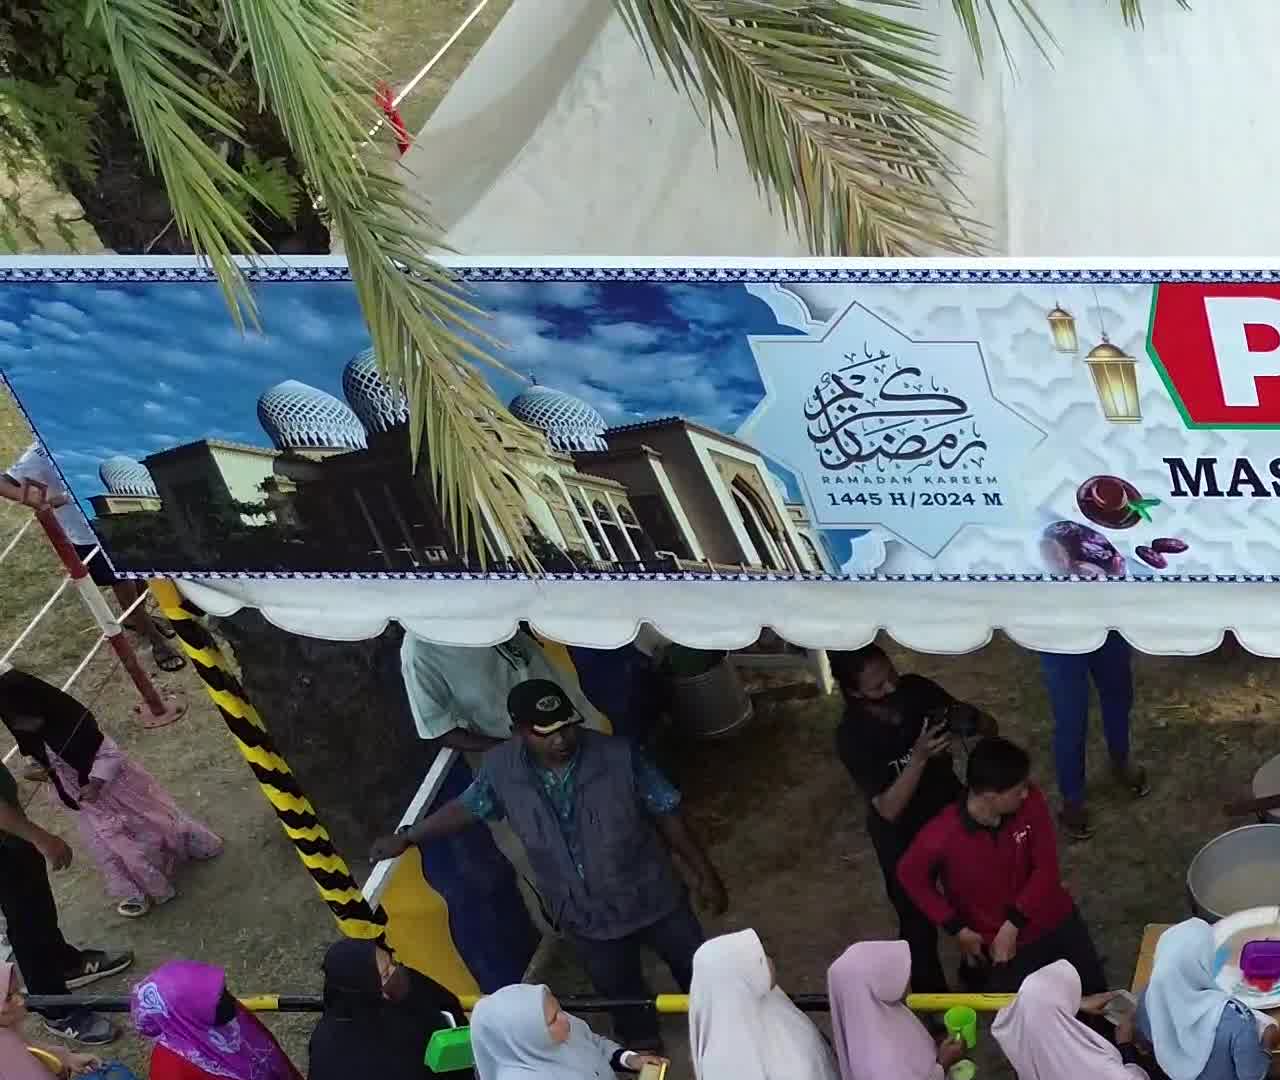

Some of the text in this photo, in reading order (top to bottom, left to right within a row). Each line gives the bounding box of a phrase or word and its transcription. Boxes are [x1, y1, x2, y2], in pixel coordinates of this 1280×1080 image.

[821, 475, 999, 485] RAMADAN KAREEM
[827, 492, 882, 506] 1445
[982, 492, 1003, 506] M
